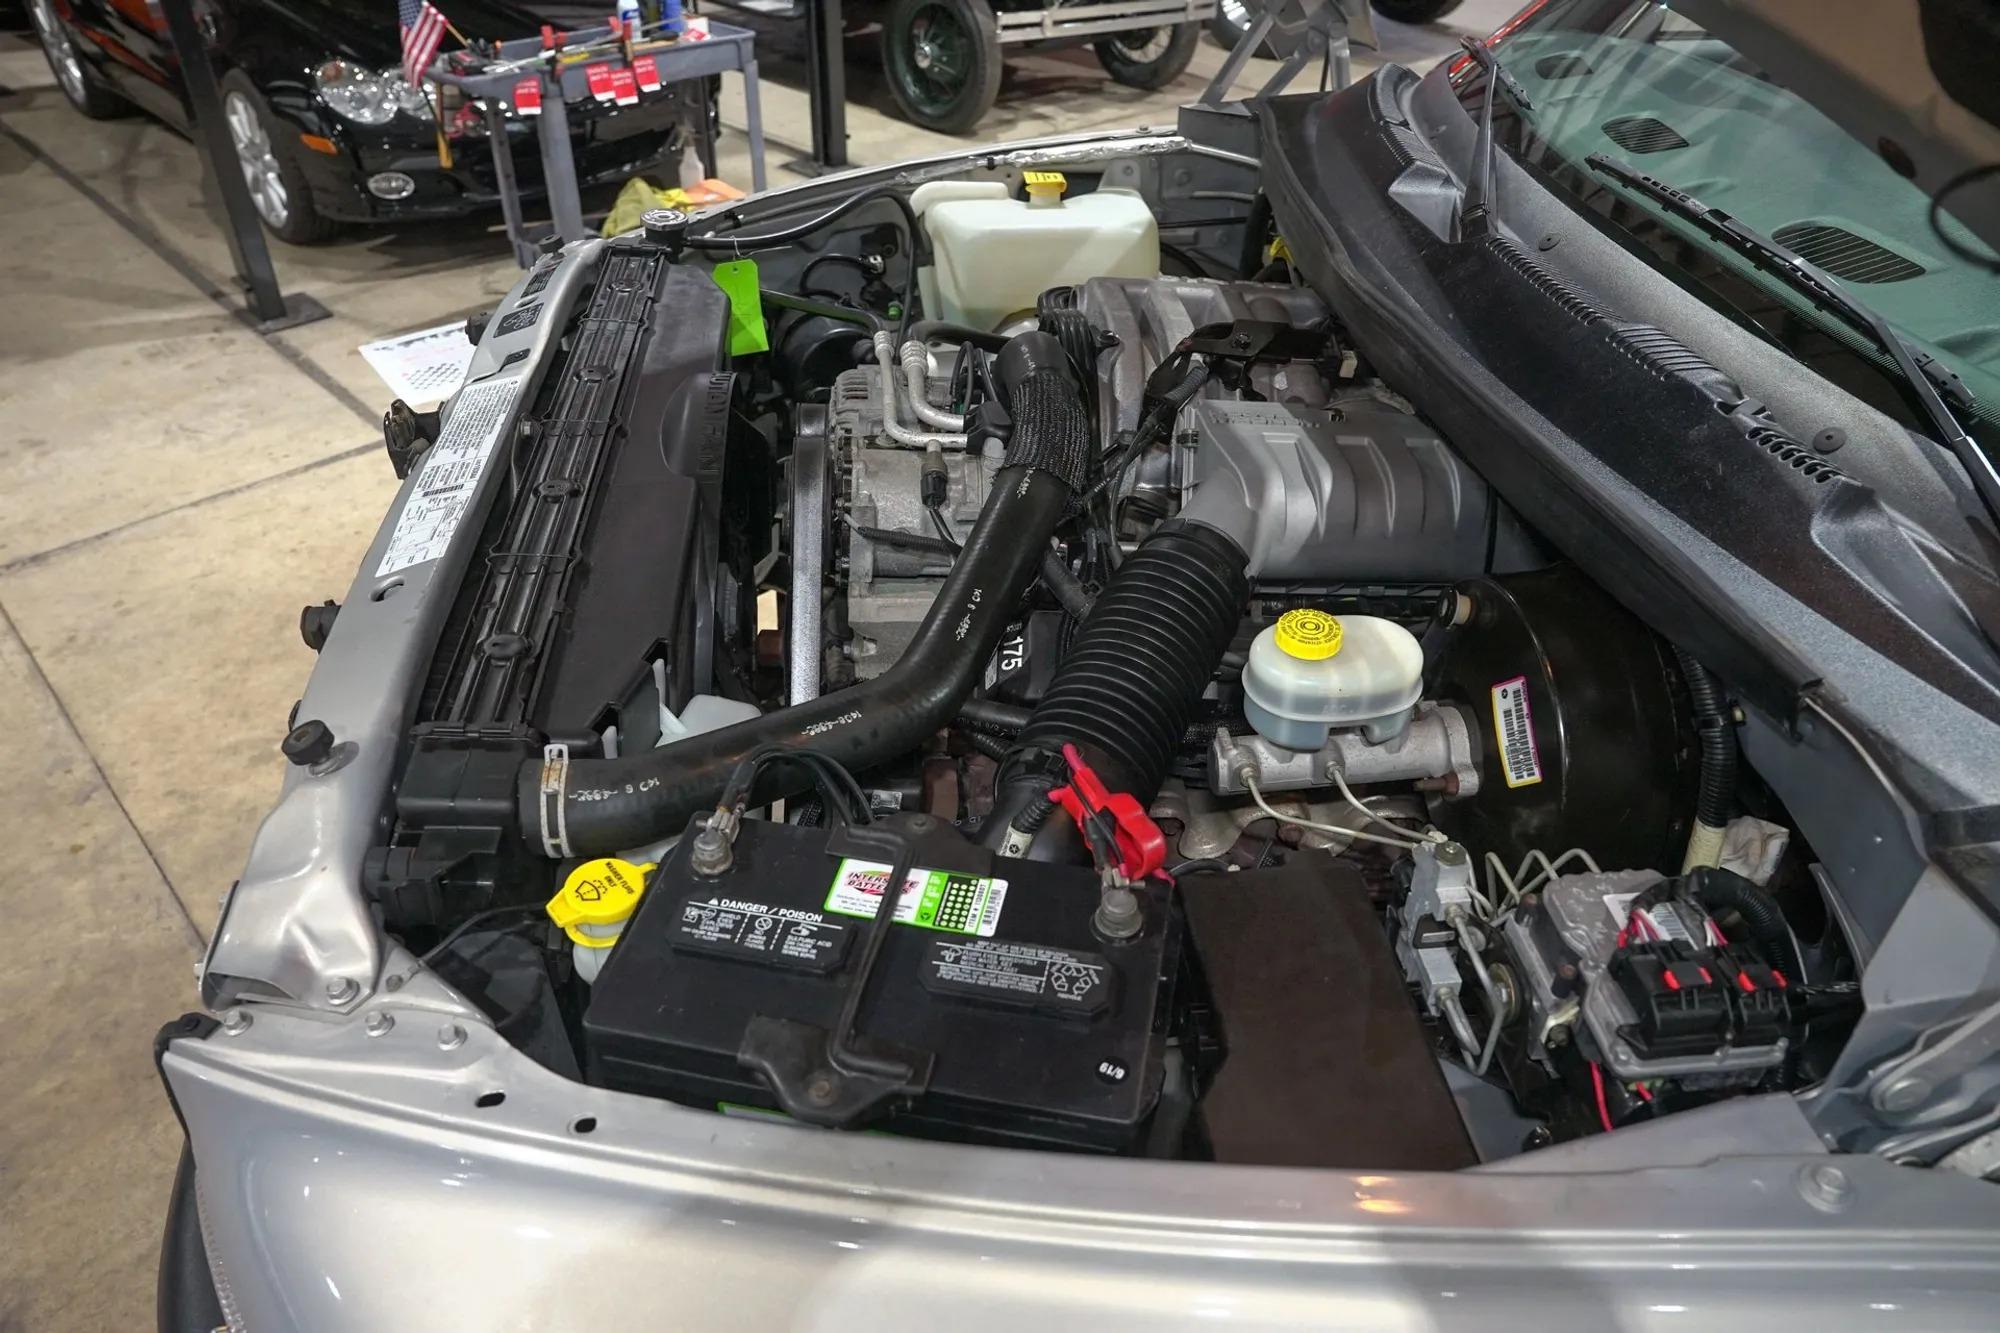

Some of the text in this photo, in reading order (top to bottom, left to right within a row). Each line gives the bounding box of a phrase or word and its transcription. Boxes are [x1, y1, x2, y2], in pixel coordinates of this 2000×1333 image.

[1001, 636, 1024, 671] 175
[847, 878, 911, 895] BATTES
[848, 871, 920, 888] INTERSTE
[720, 899, 767, 914] DANGER
[780, 908, 823, 922] POISON
